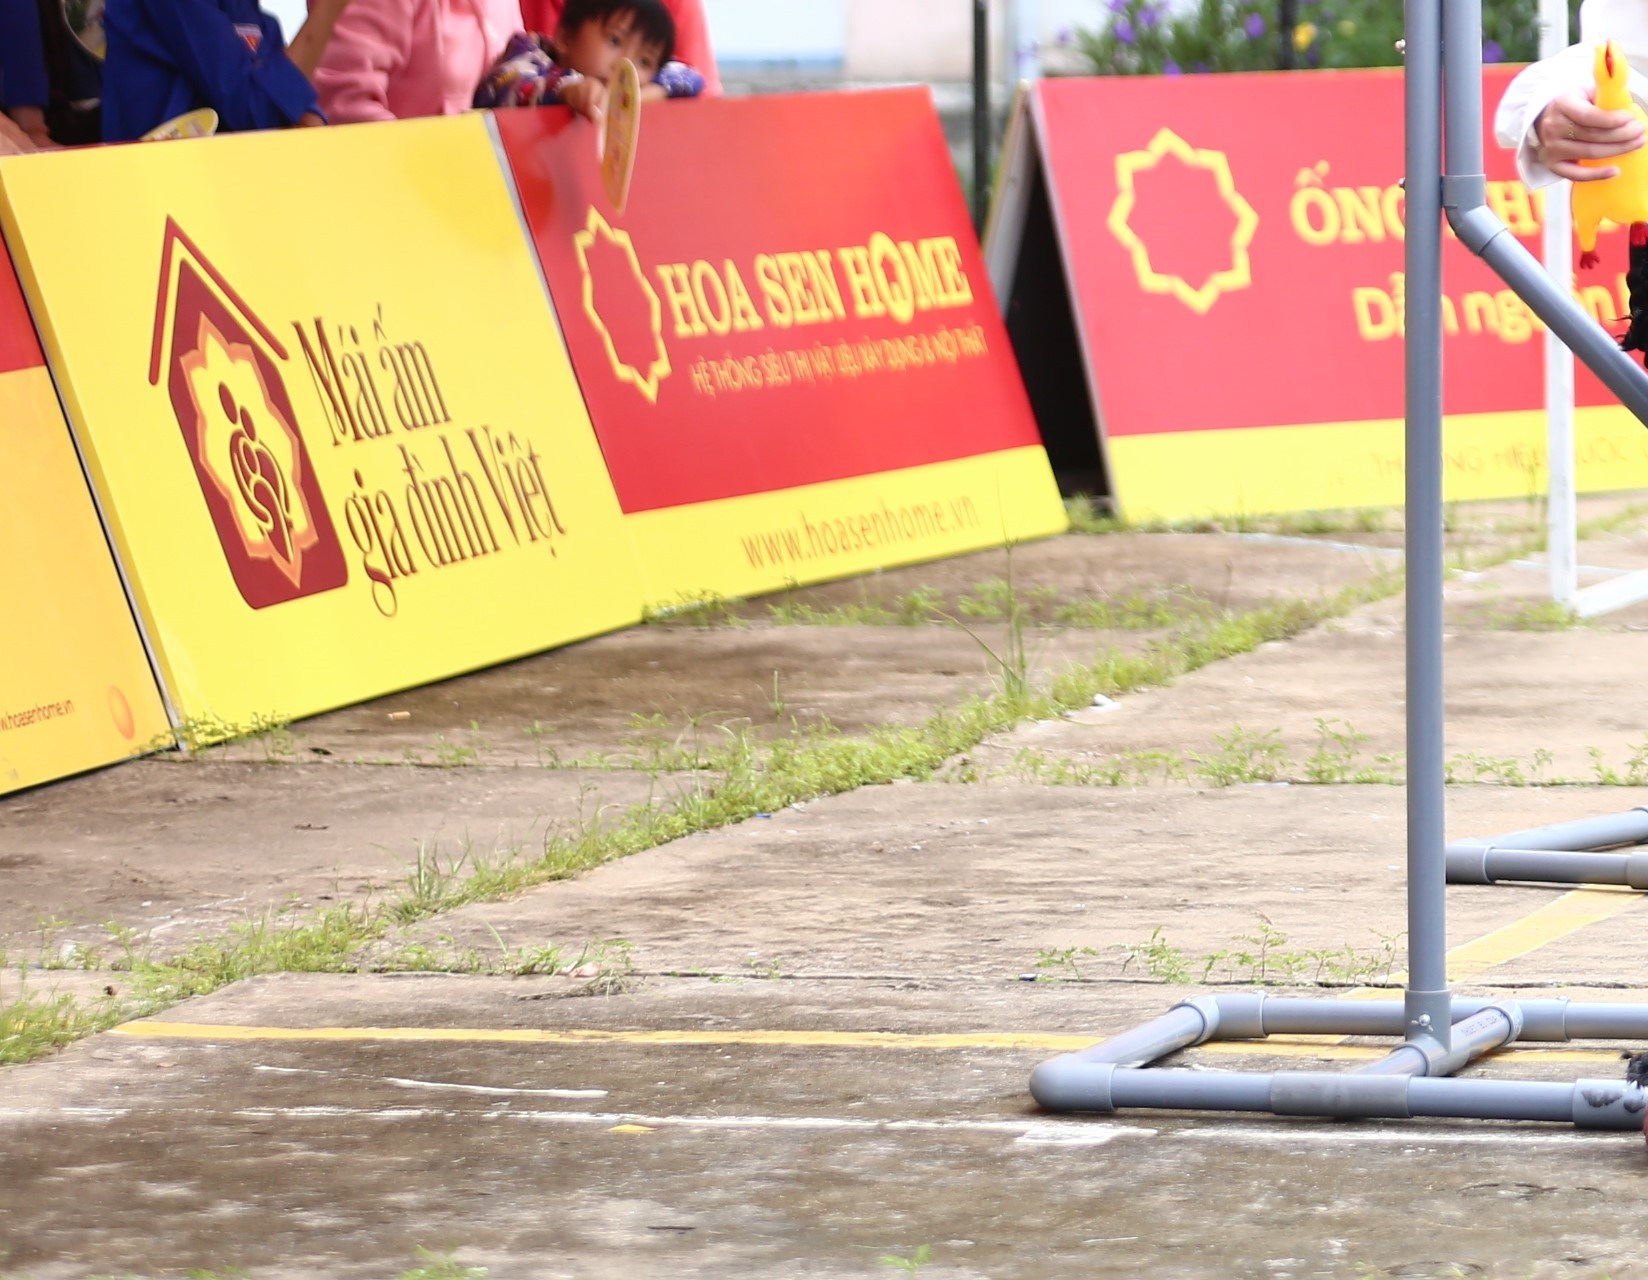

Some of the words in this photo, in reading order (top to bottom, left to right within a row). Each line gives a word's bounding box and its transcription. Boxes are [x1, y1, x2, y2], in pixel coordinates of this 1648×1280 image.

[656, 257, 764, 338] HOA
[754, 248, 847, 329] SEN
[837, 230, 975, 326] HOME
[290, 316, 395, 447] Mái
[372, 300, 454, 432] ấm
[691, 354, 716, 401] HỆ
[709, 349, 765, 394] THỐNG
[345, 468, 419, 618] gia
[397, 433, 502, 569] đình
[465, 424, 568, 559] Việt
[741, 495, 981, 569] www.hoasenhome.vn
